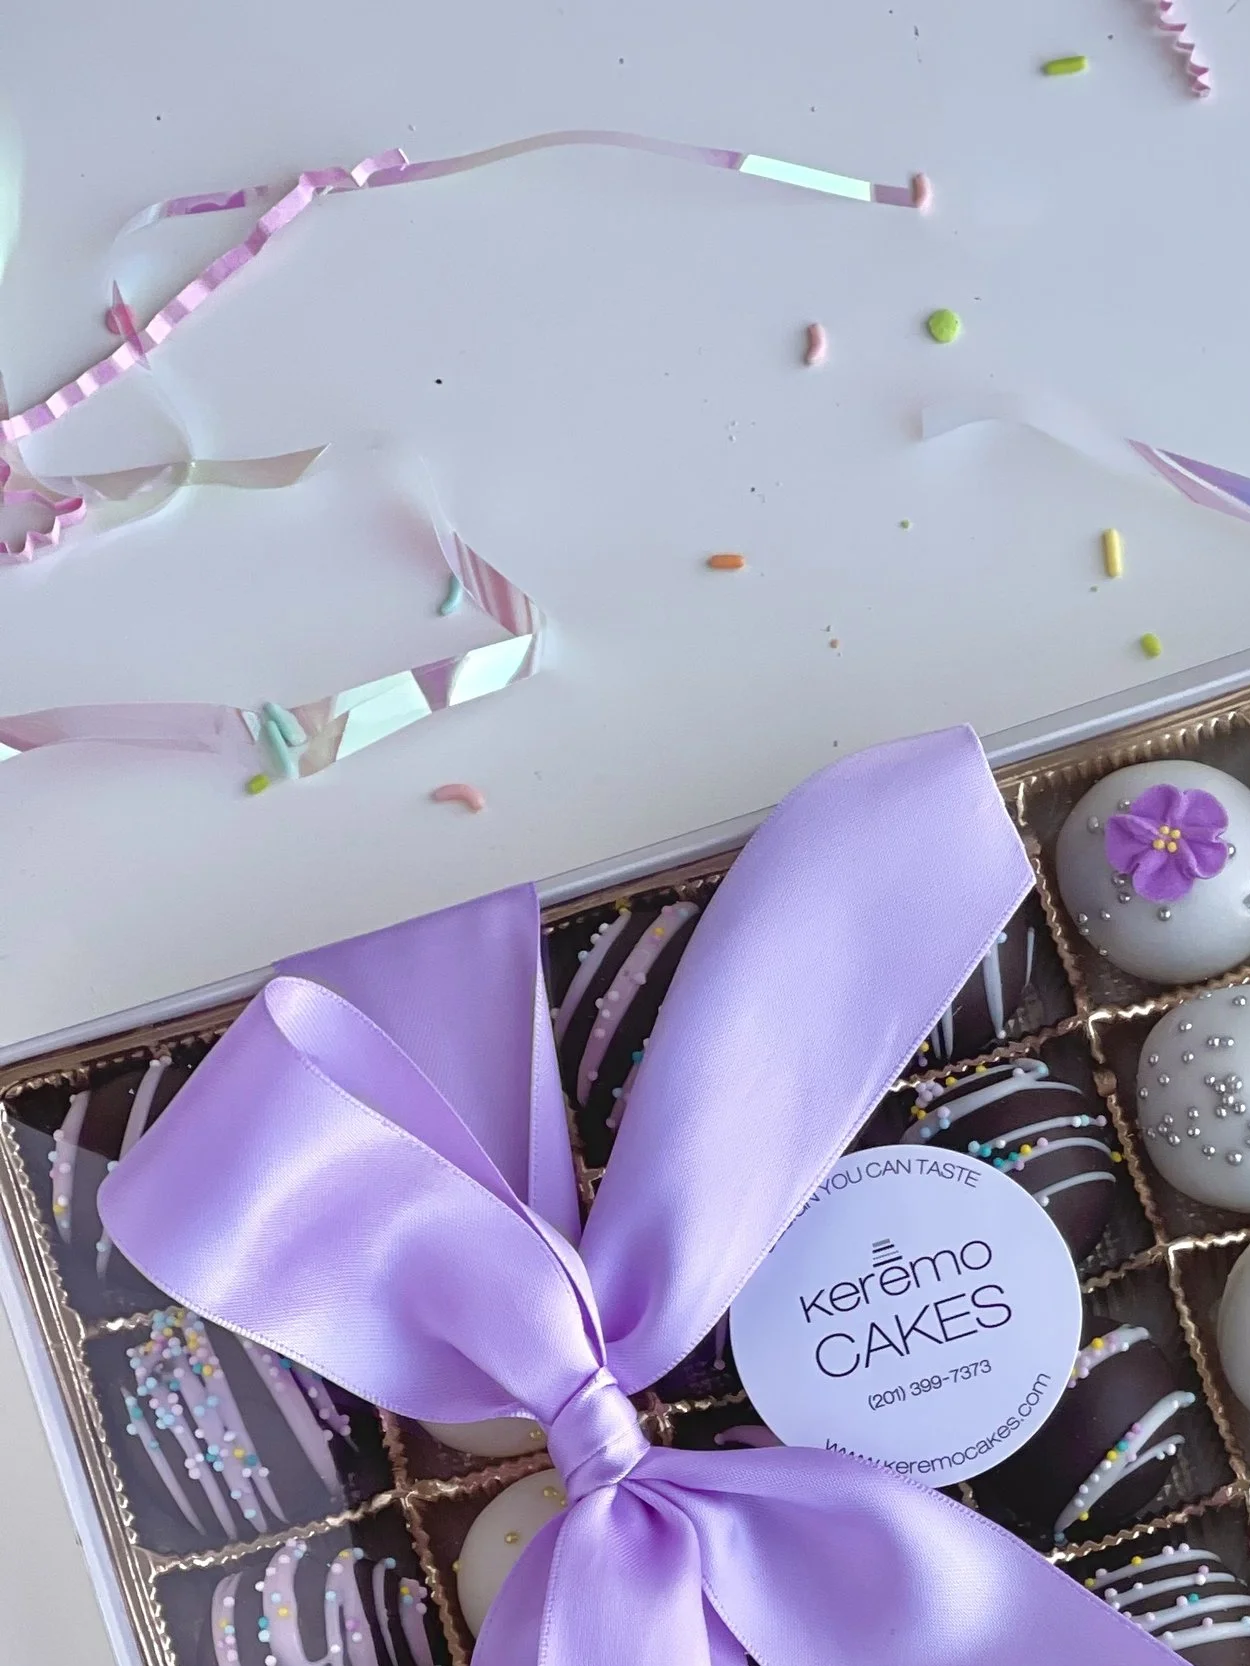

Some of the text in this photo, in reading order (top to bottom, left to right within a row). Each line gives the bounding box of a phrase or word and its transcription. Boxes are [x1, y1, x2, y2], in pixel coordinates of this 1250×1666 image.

[819, 1158, 982, 1195] YOU CAN TASTE
[815, 1284, 1012, 1378] CAKES
[868, 1359, 992, 1411] (201) 399-7373
